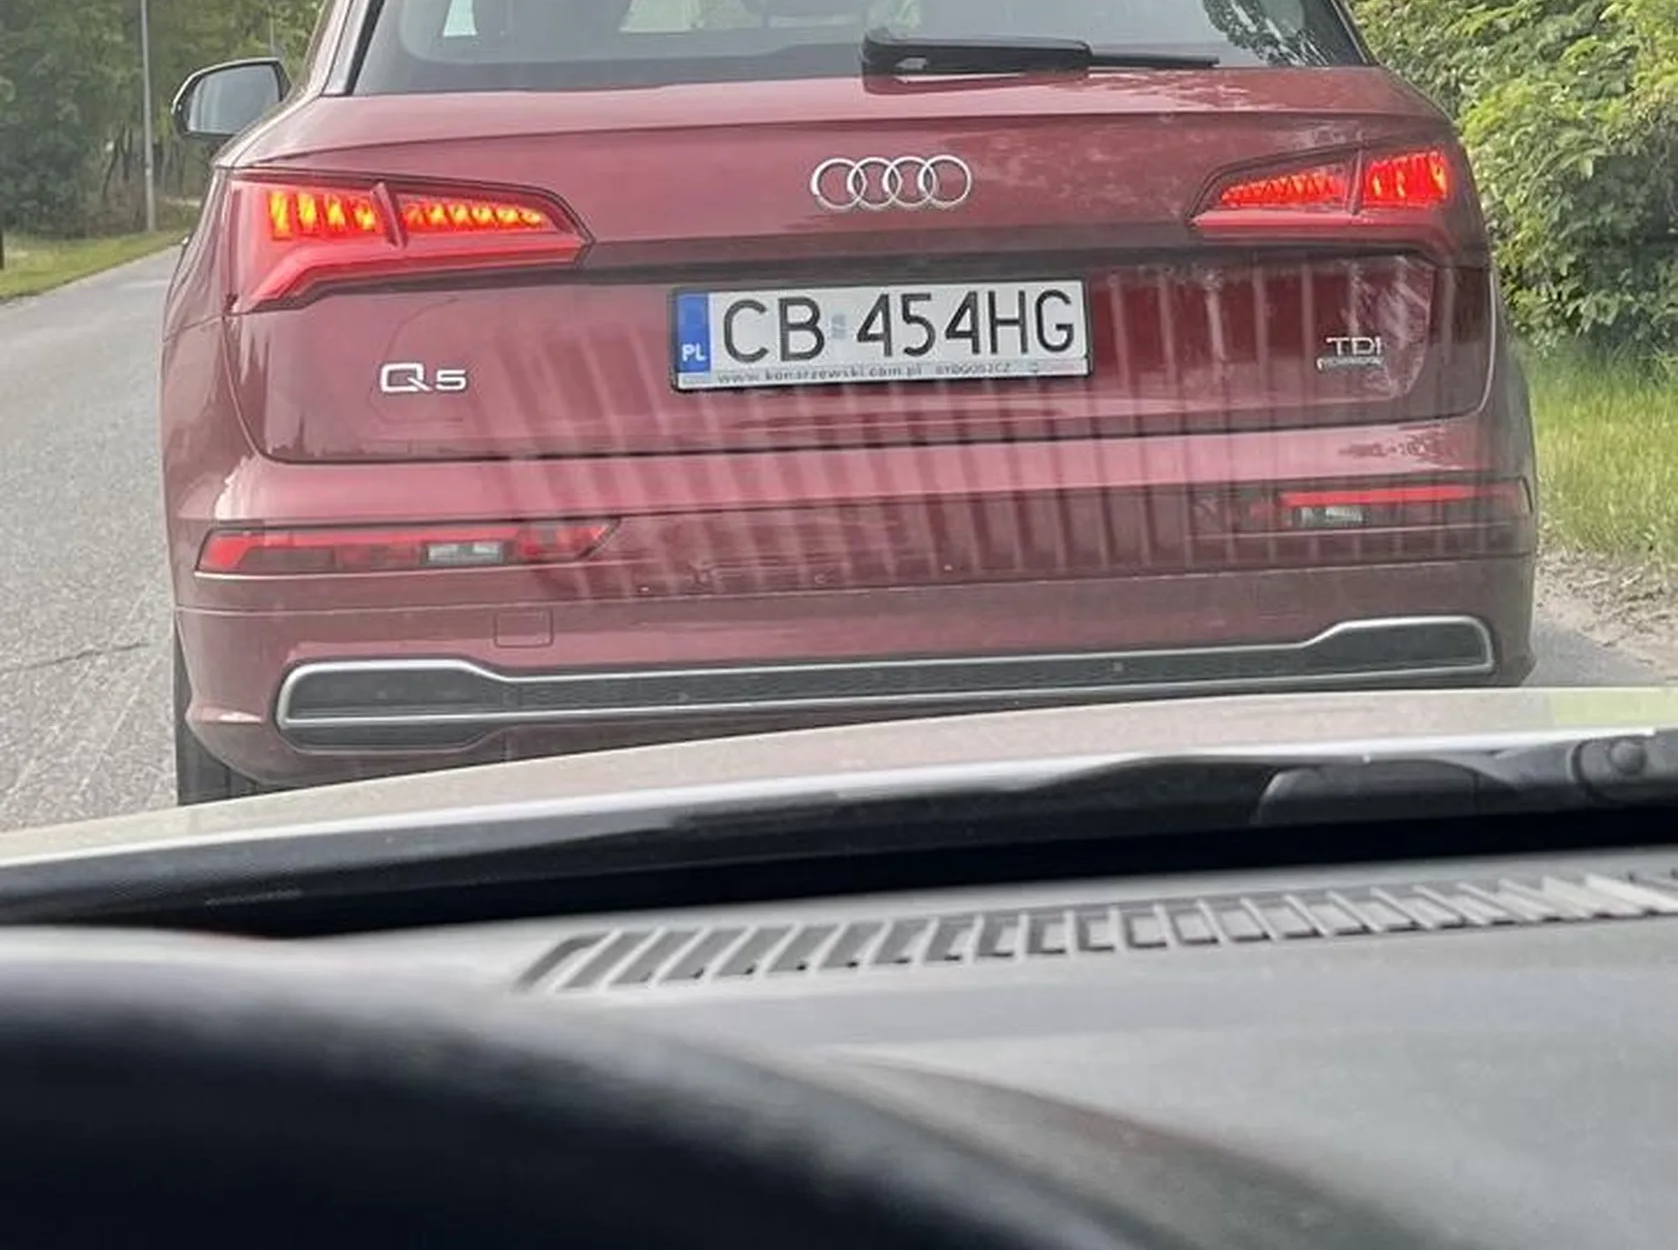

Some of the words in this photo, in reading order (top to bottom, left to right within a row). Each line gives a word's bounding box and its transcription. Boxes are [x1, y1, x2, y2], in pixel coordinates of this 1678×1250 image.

[723, 296, 826, 363] CB
[856, 288, 1074, 357] 454HG
[682, 343, 706, 362] PL
[1325, 336, 1381, 356] TDI
[381, 362, 467, 392] Q5
